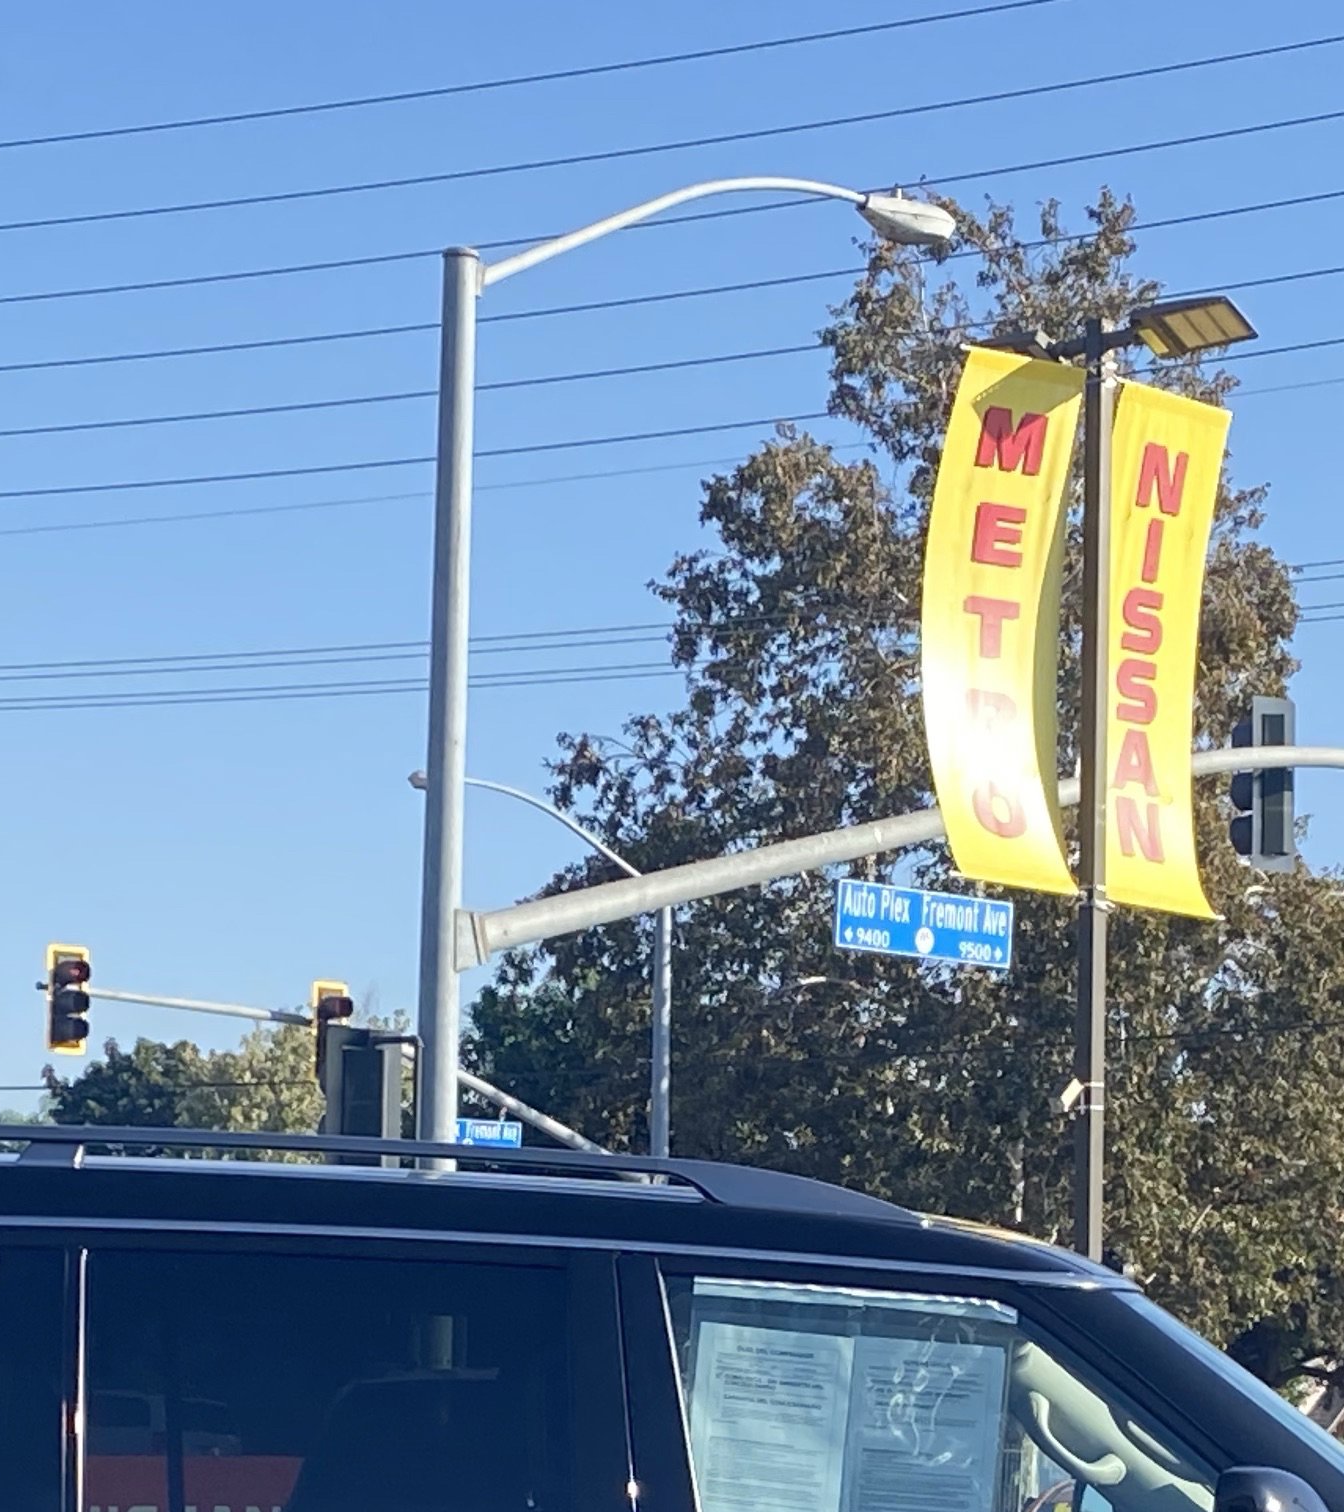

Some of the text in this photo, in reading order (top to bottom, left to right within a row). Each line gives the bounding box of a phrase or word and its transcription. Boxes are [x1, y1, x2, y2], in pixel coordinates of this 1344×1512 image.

[1115, 442, 1189, 863] NISSAN
[843, 886, 1007, 937] Auto Plex Fremont Ave
[856, 927, 890, 948] 9400
[959, 942, 992, 962] 9500
